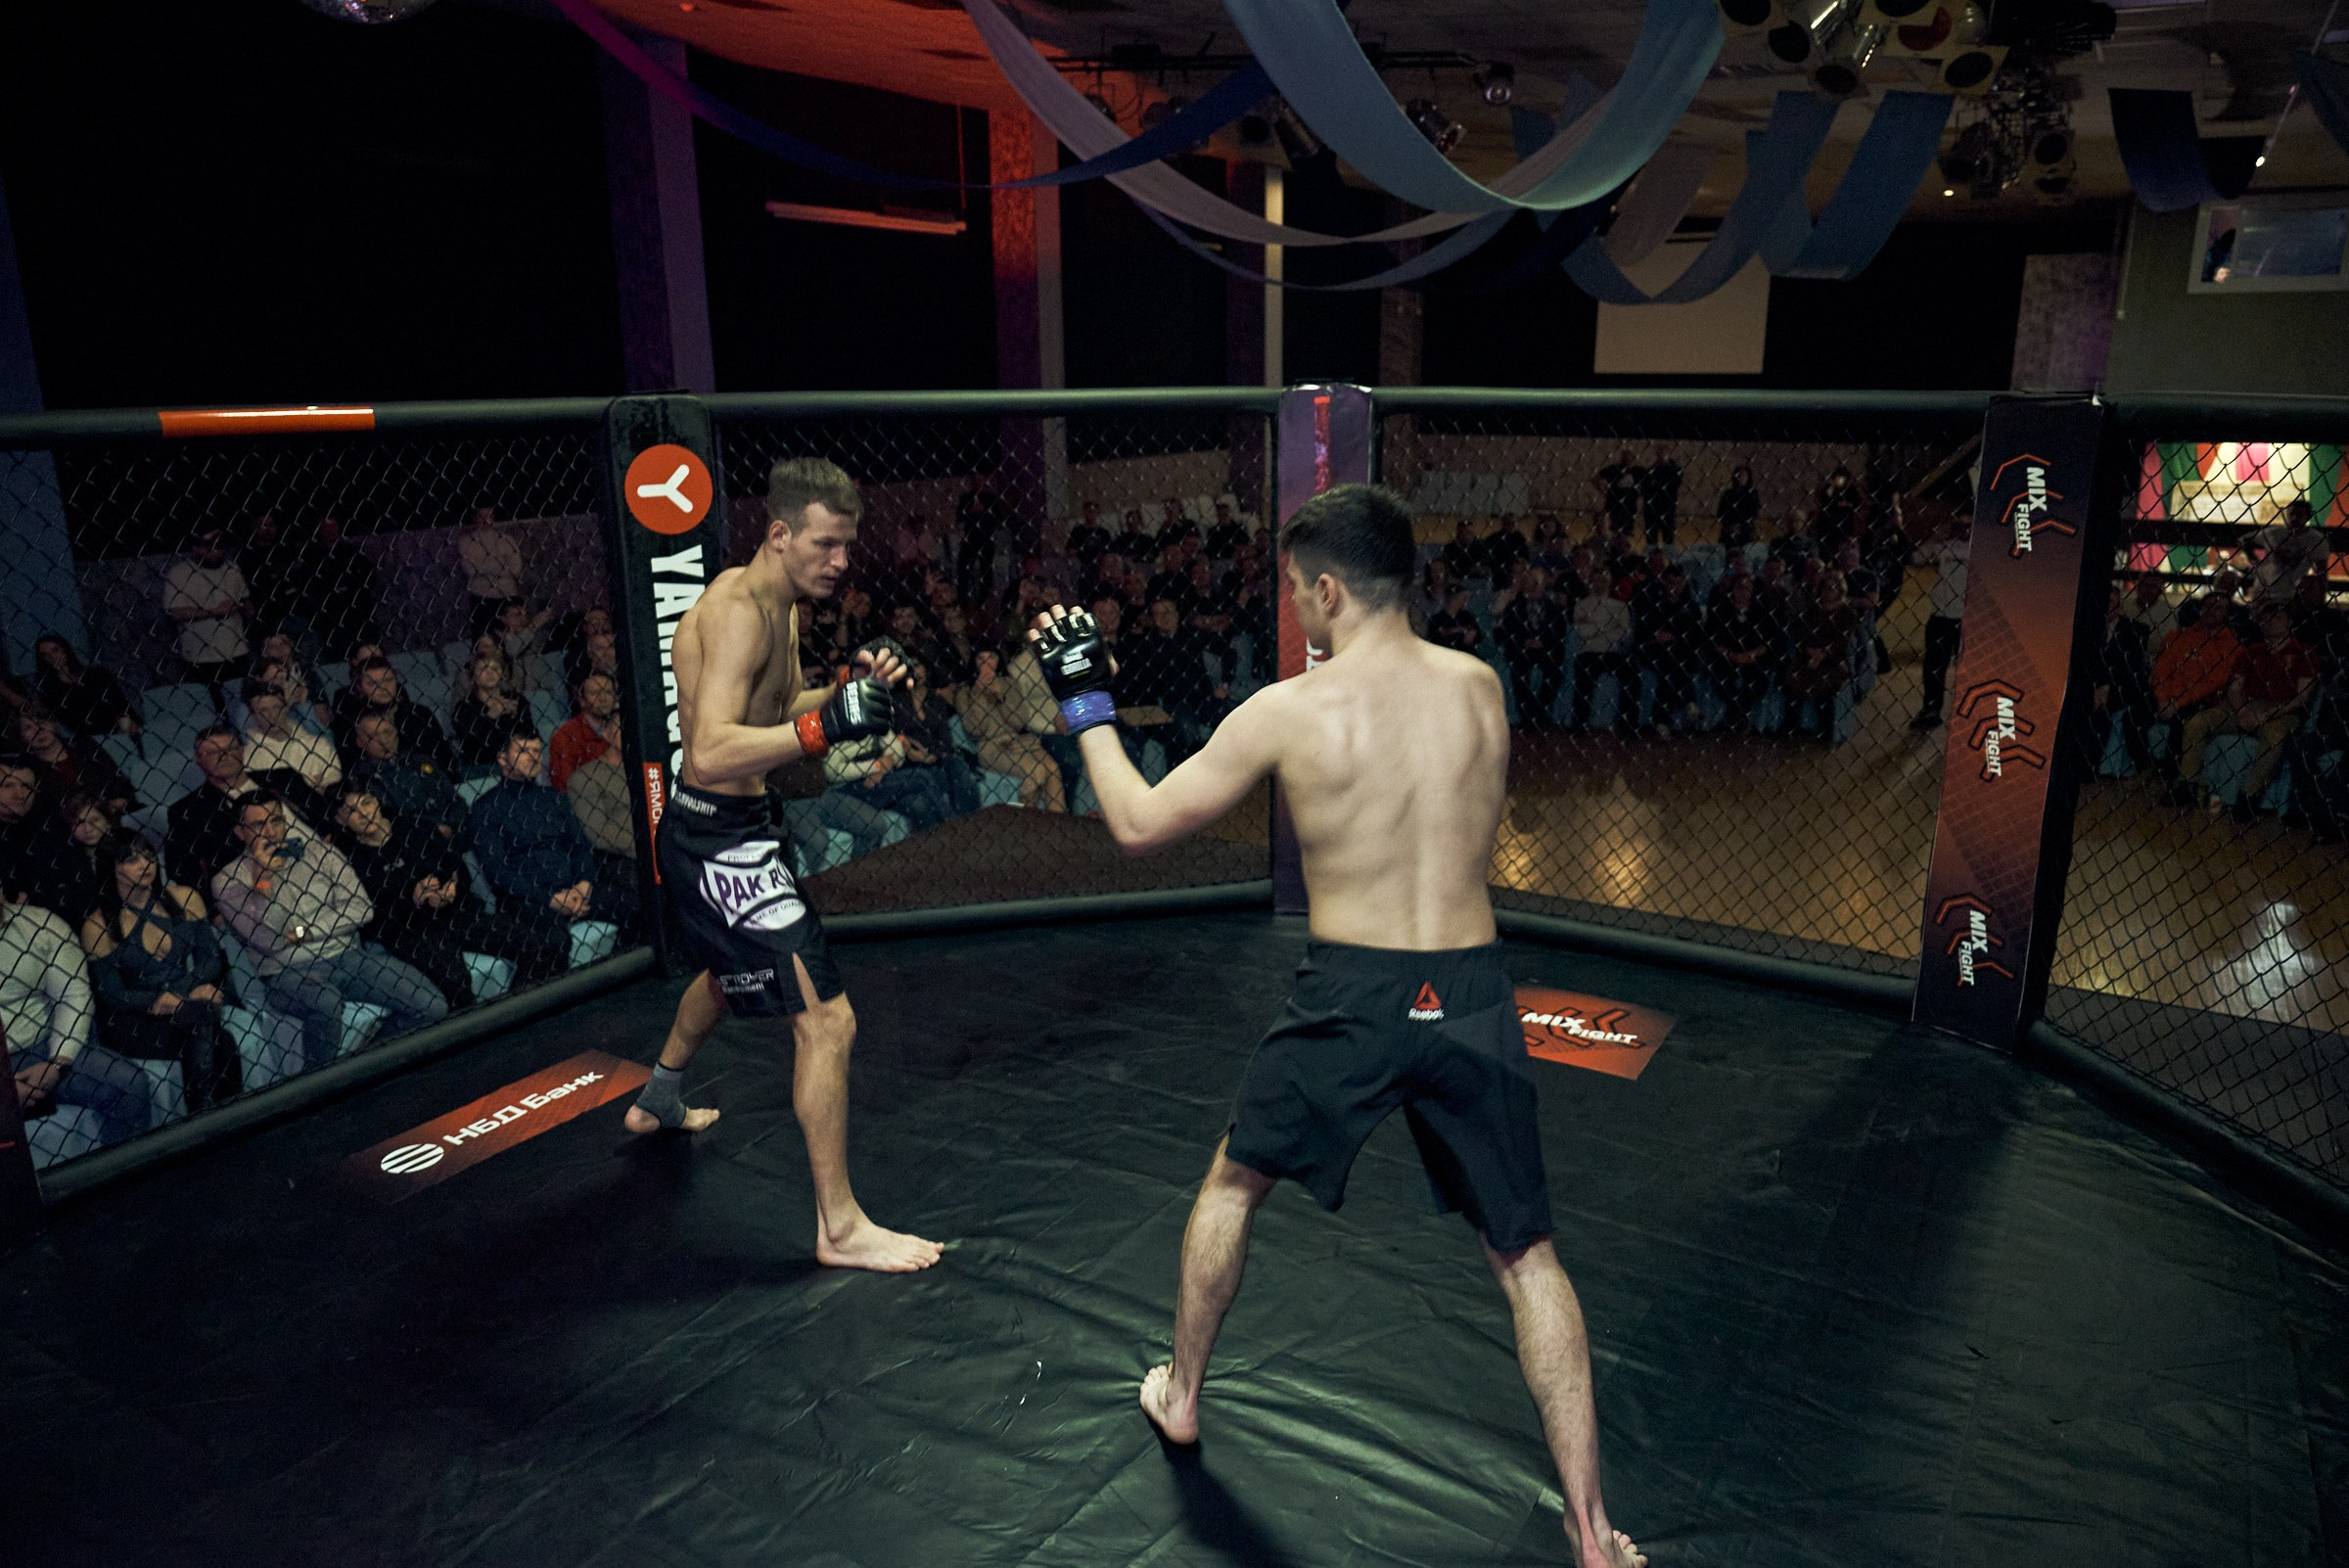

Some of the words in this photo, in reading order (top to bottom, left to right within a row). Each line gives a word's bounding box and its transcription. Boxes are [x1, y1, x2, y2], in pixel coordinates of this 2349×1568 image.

[2026, 466, 2048, 512] MIX
[2016, 502, 2033, 552] FIGHT
[1997, 696, 2016, 741] MIX
[1988, 730, 2002, 776] FIGHT
[1969, 909, 1989, 953] MIX
[1960, 940, 1975, 987] FIGHT
[1522, 1012, 1587, 1030] MIX
[1568, 1026, 1638, 1044] FIGHT
[442, 1104, 528, 1146] НБД
[520, 1071, 605, 1109] Банк
